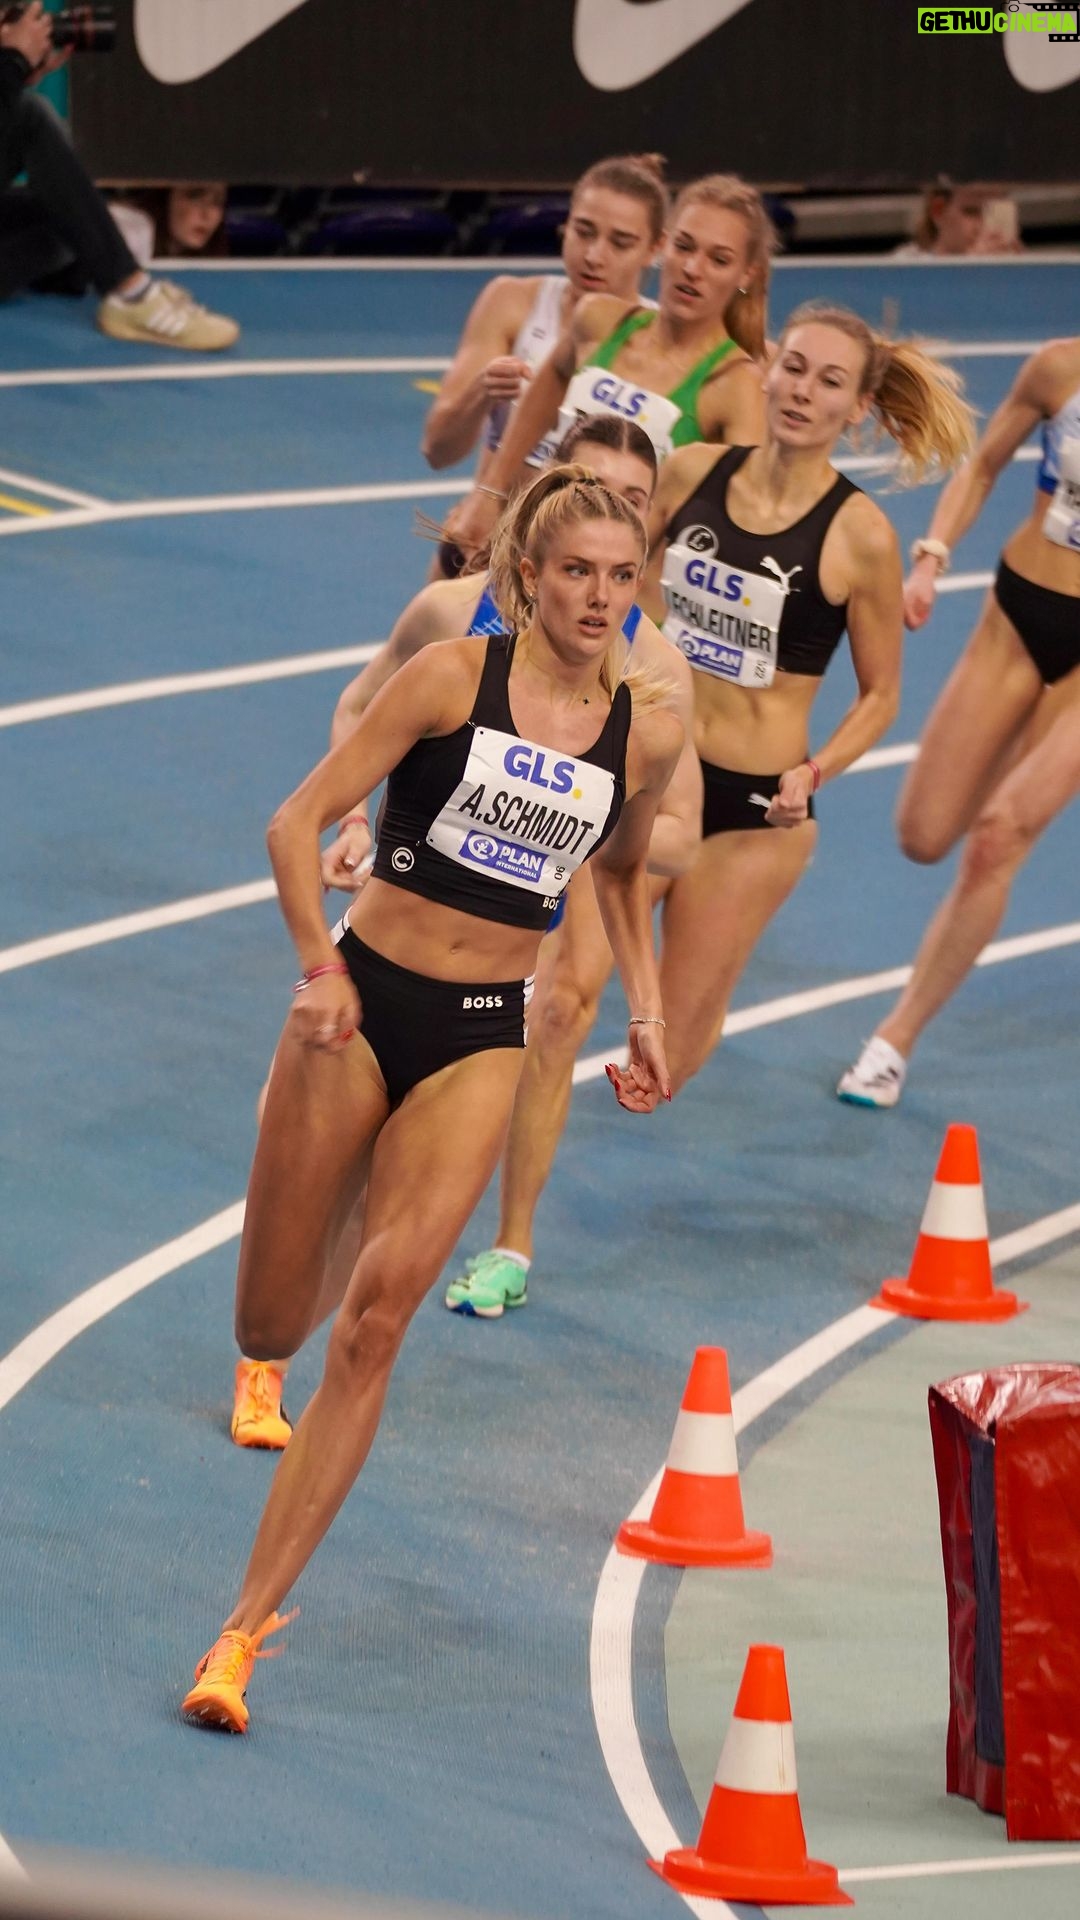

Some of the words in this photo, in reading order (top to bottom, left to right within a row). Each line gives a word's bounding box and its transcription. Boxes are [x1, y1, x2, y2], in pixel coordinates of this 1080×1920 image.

[458, 783, 594, 855] A.SCHMIDT
[499, 845, 542, 871] PLAN
[462, 995, 503, 1009] BOSS
